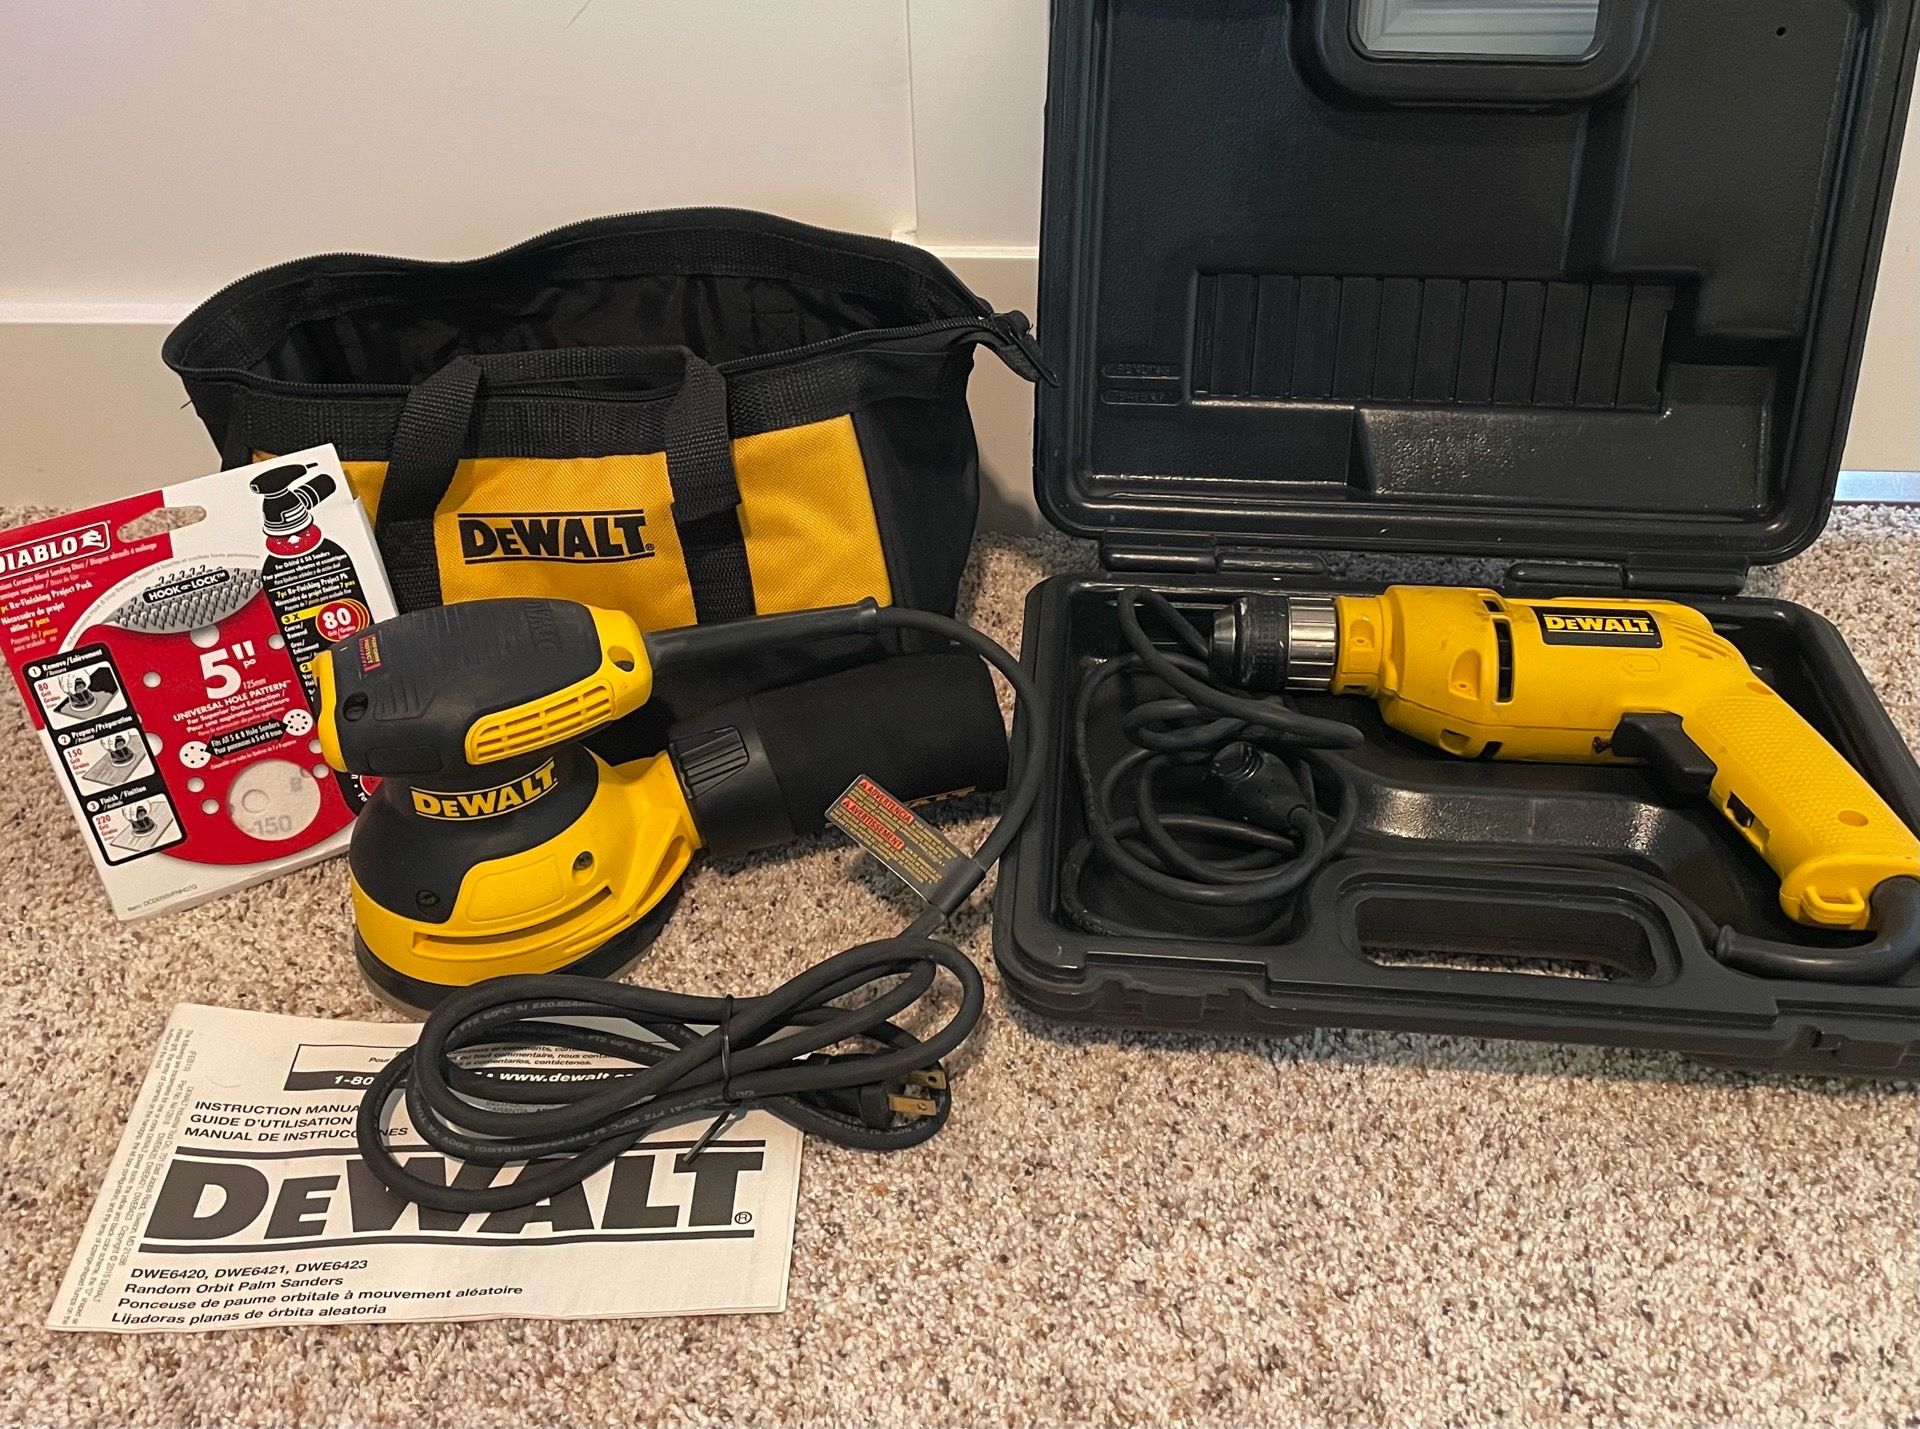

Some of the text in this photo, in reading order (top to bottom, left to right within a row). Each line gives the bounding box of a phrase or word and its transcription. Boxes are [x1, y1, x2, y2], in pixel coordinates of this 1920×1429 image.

[51, 586, 75, 598] Project
[75, 580, 93, 591] Pack
[149, 586, 182, 601] HOOK
[322, 608, 352, 630] 80
[243, 658, 257, 670] po
[37, 682, 49, 692] 80
[173, 700, 224, 722] UNIVERSAL
[225, 692, 249, 705] HOLE
[66, 748, 83, 758] 150
[867, 786, 912, 825] ADVERTENCIA
[95, 814, 112, 825] 220
[850, 803, 904, 849] AVERTISSEMENT
[195, 1101, 361, 1116] INSTRUCTION MANUA
[190, 1114, 353, 1129] GUIDE D'UTILISATION
[184, 1127, 253, 1141] MANUAL
[258, 1131, 279, 1142] DE
[130, 1259, 369, 1281] DWE6420, DWE6421, DWE6423
[124, 1276, 344, 1295] Random Orbit Palm Sanders
[118, 1285, 524, 1310] Ponceuse de paume orbitale à mouvement aléatoire
[111, 1304, 388, 1327] Lijadoras planas de órbita aleatoria
